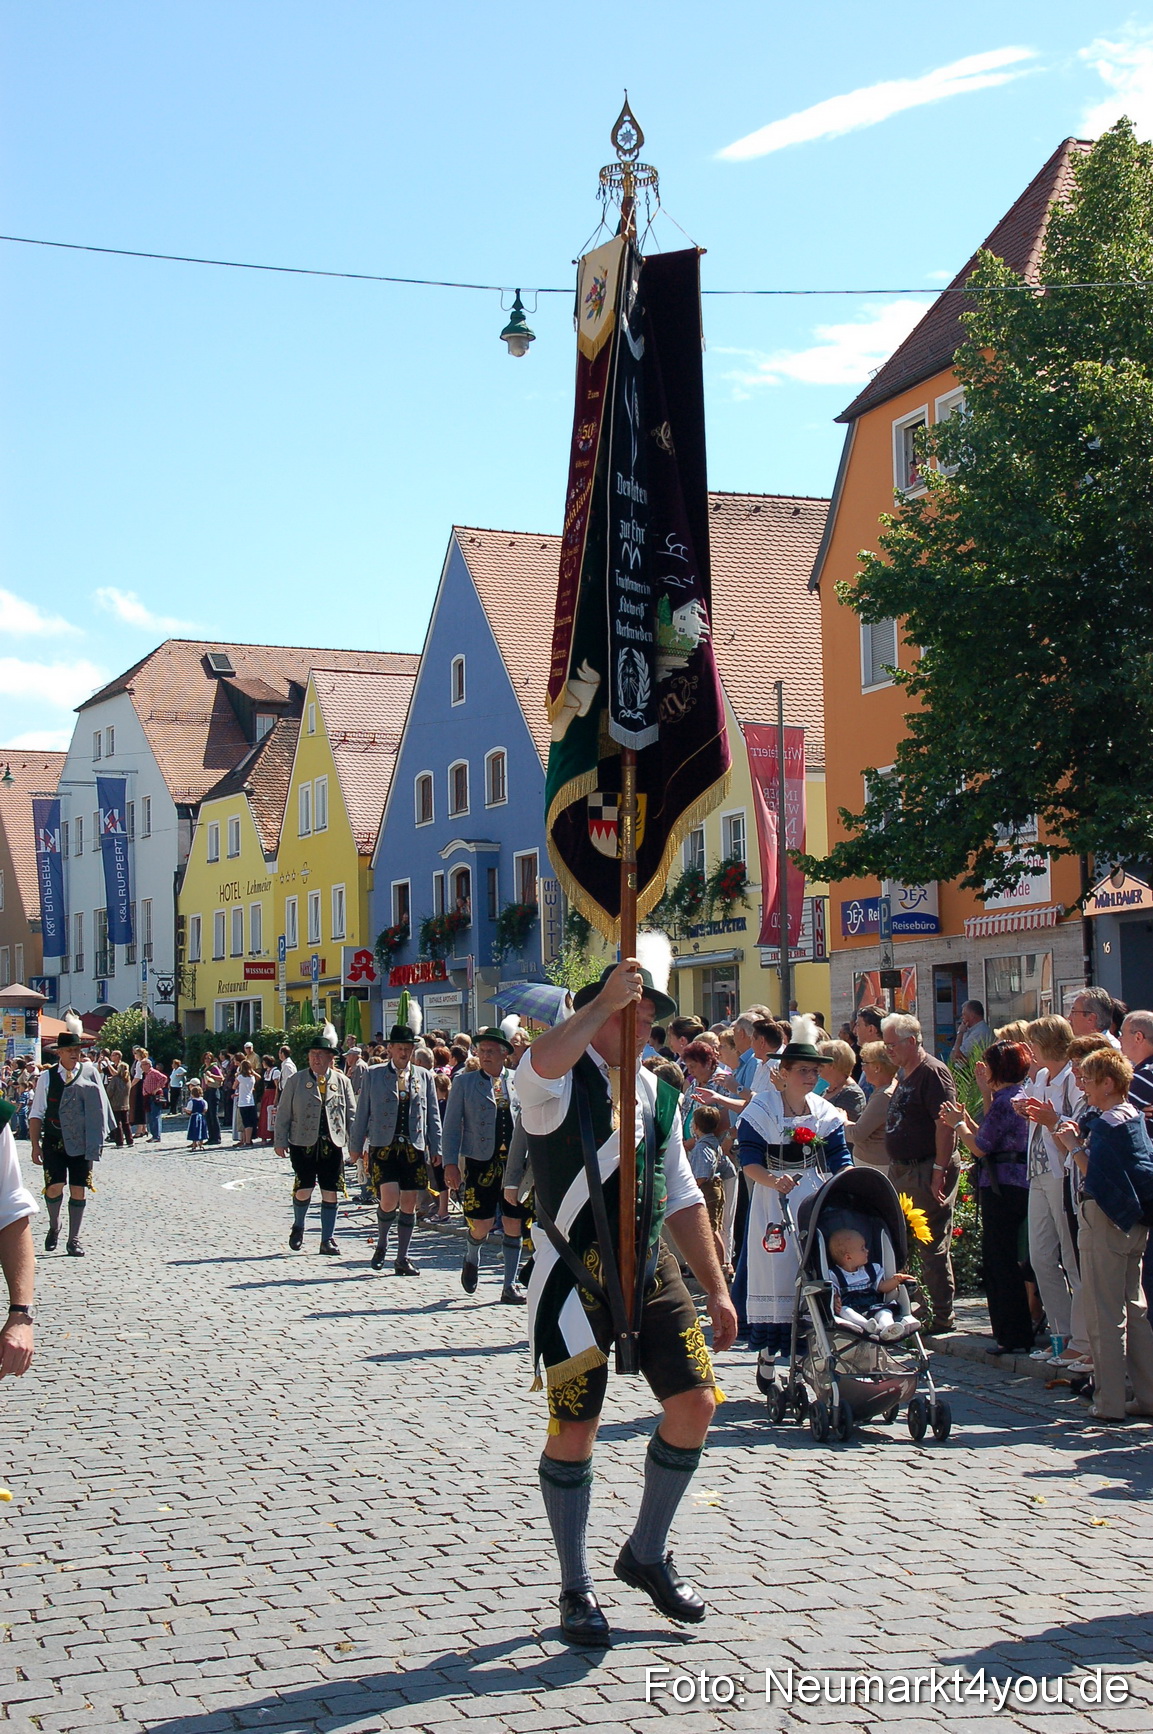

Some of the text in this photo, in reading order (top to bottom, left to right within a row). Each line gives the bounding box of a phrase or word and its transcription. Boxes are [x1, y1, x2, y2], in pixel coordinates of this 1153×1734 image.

[114, 838, 127, 897] RUPPERT
[219, 881, 242, 903] HOTEL
[1094, 888, 1144, 909] MÜHLBAUER
[815, 899, 825, 957] KINO
[892, 921, 936, 931] Reisebüro
[1102, 941, 1112, 954] 16
[245, 966, 275, 976] WISSMACH
[217, 978, 249, 995] Restaurant
